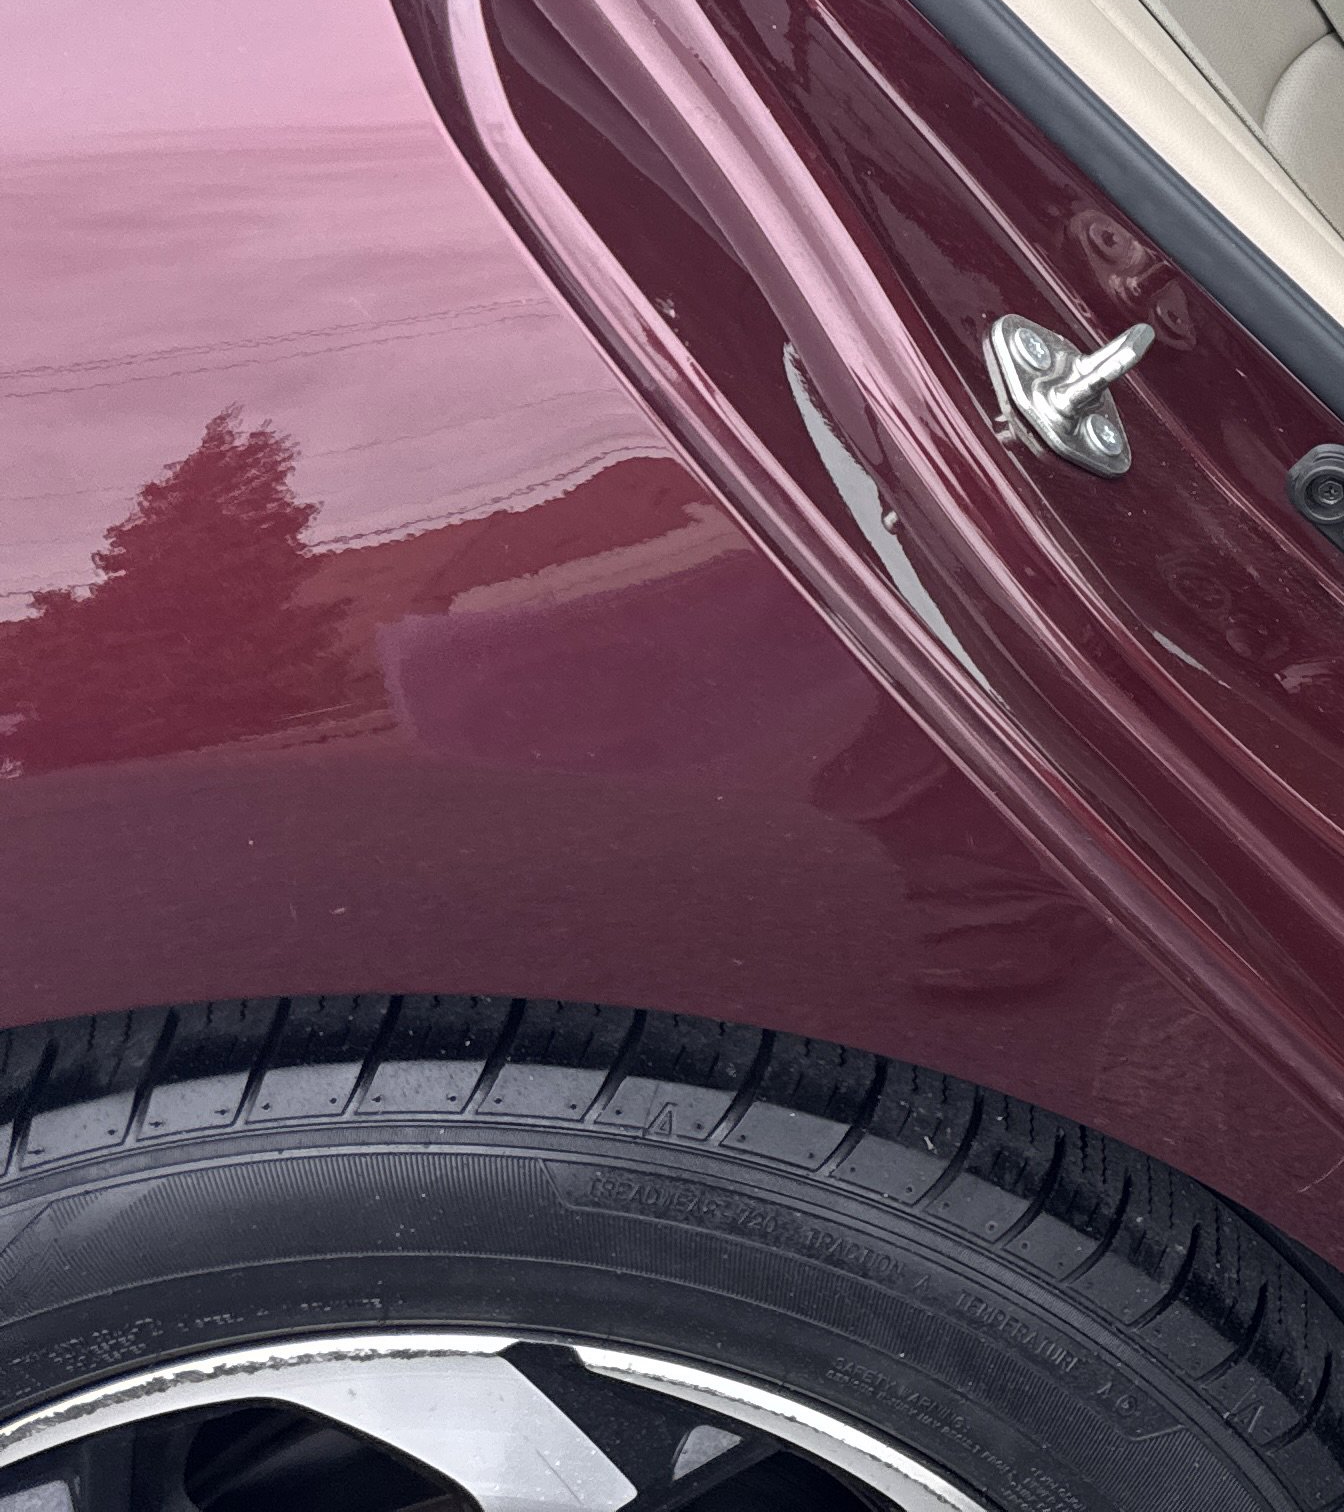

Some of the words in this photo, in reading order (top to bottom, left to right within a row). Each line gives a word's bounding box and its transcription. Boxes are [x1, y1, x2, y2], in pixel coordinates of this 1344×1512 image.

[736, 1206, 778, 1233] 720
[805, 1227, 905, 1274] TRACTION
[956, 1288, 1082, 1373] TEMPERATURE
[833, 1356, 897, 1391] SAFETY
